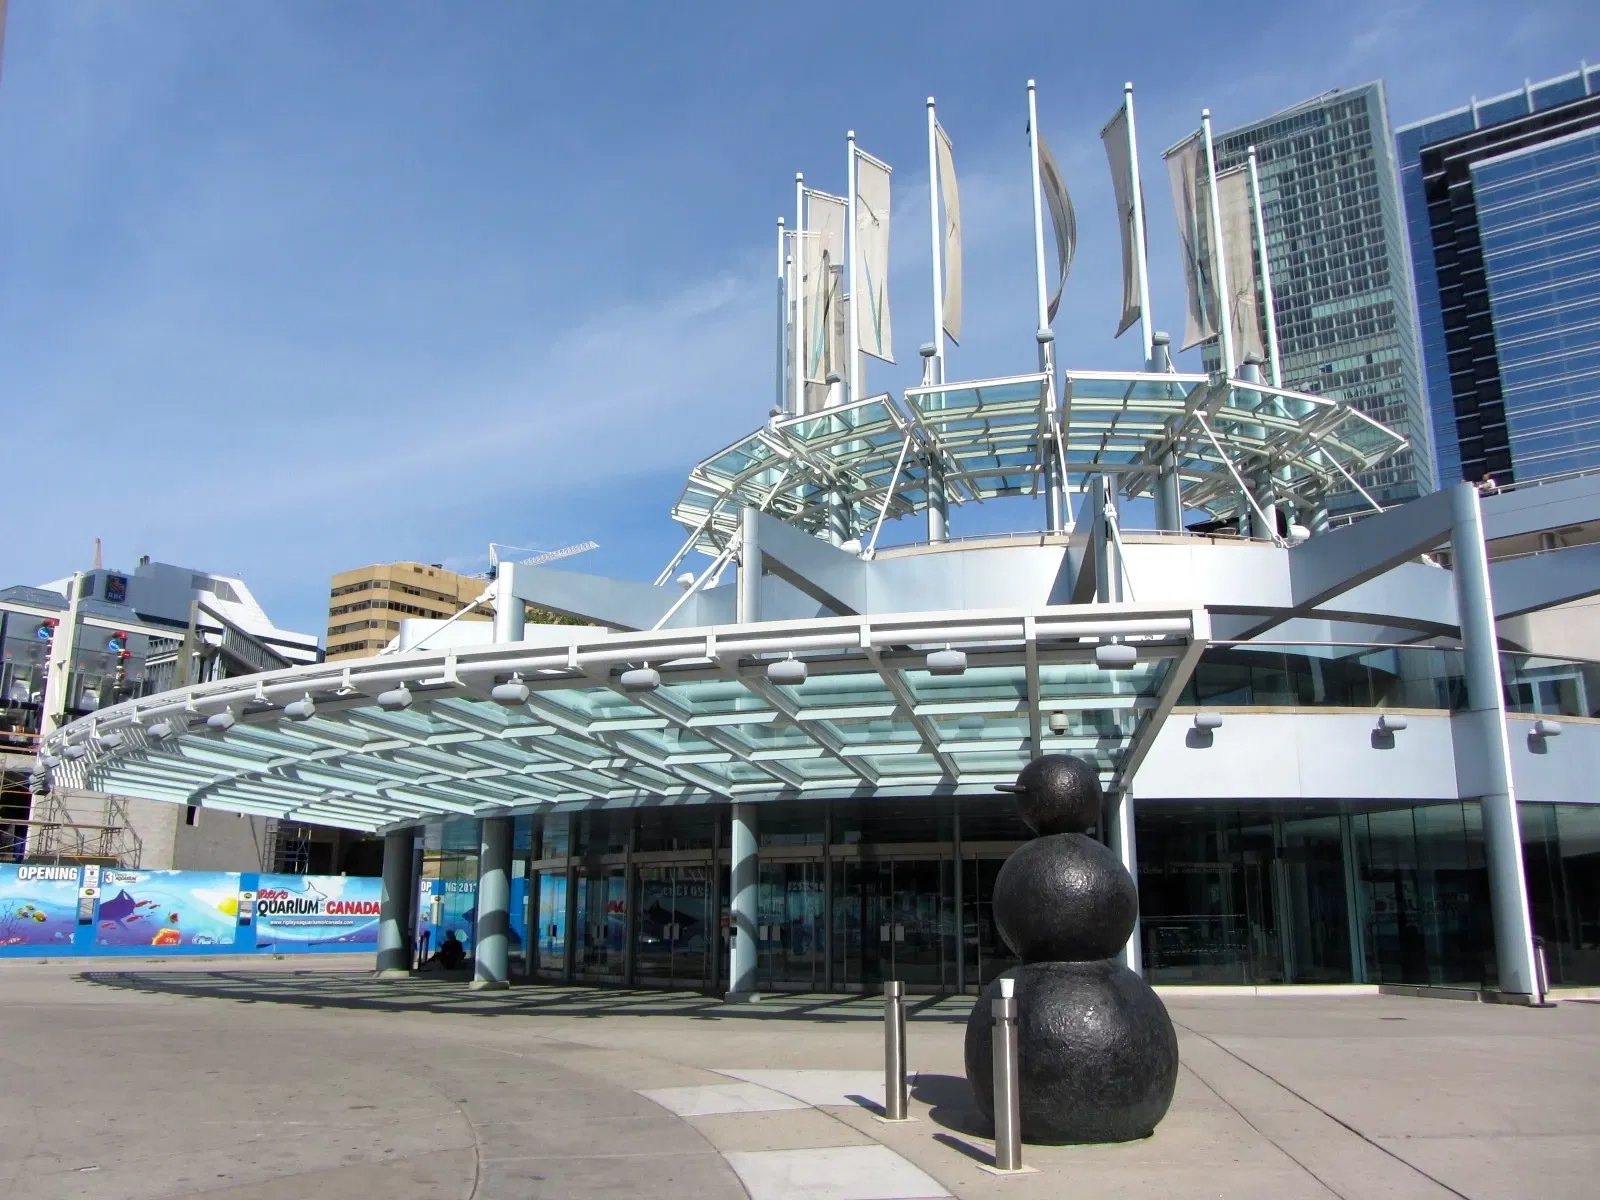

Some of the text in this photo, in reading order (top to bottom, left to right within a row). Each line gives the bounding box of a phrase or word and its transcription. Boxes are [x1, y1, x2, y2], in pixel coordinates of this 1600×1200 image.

[18, 866, 77, 880] OPENING
[257, 898, 318, 917] QUARIUM
[326, 901, 381, 915] CANADA
